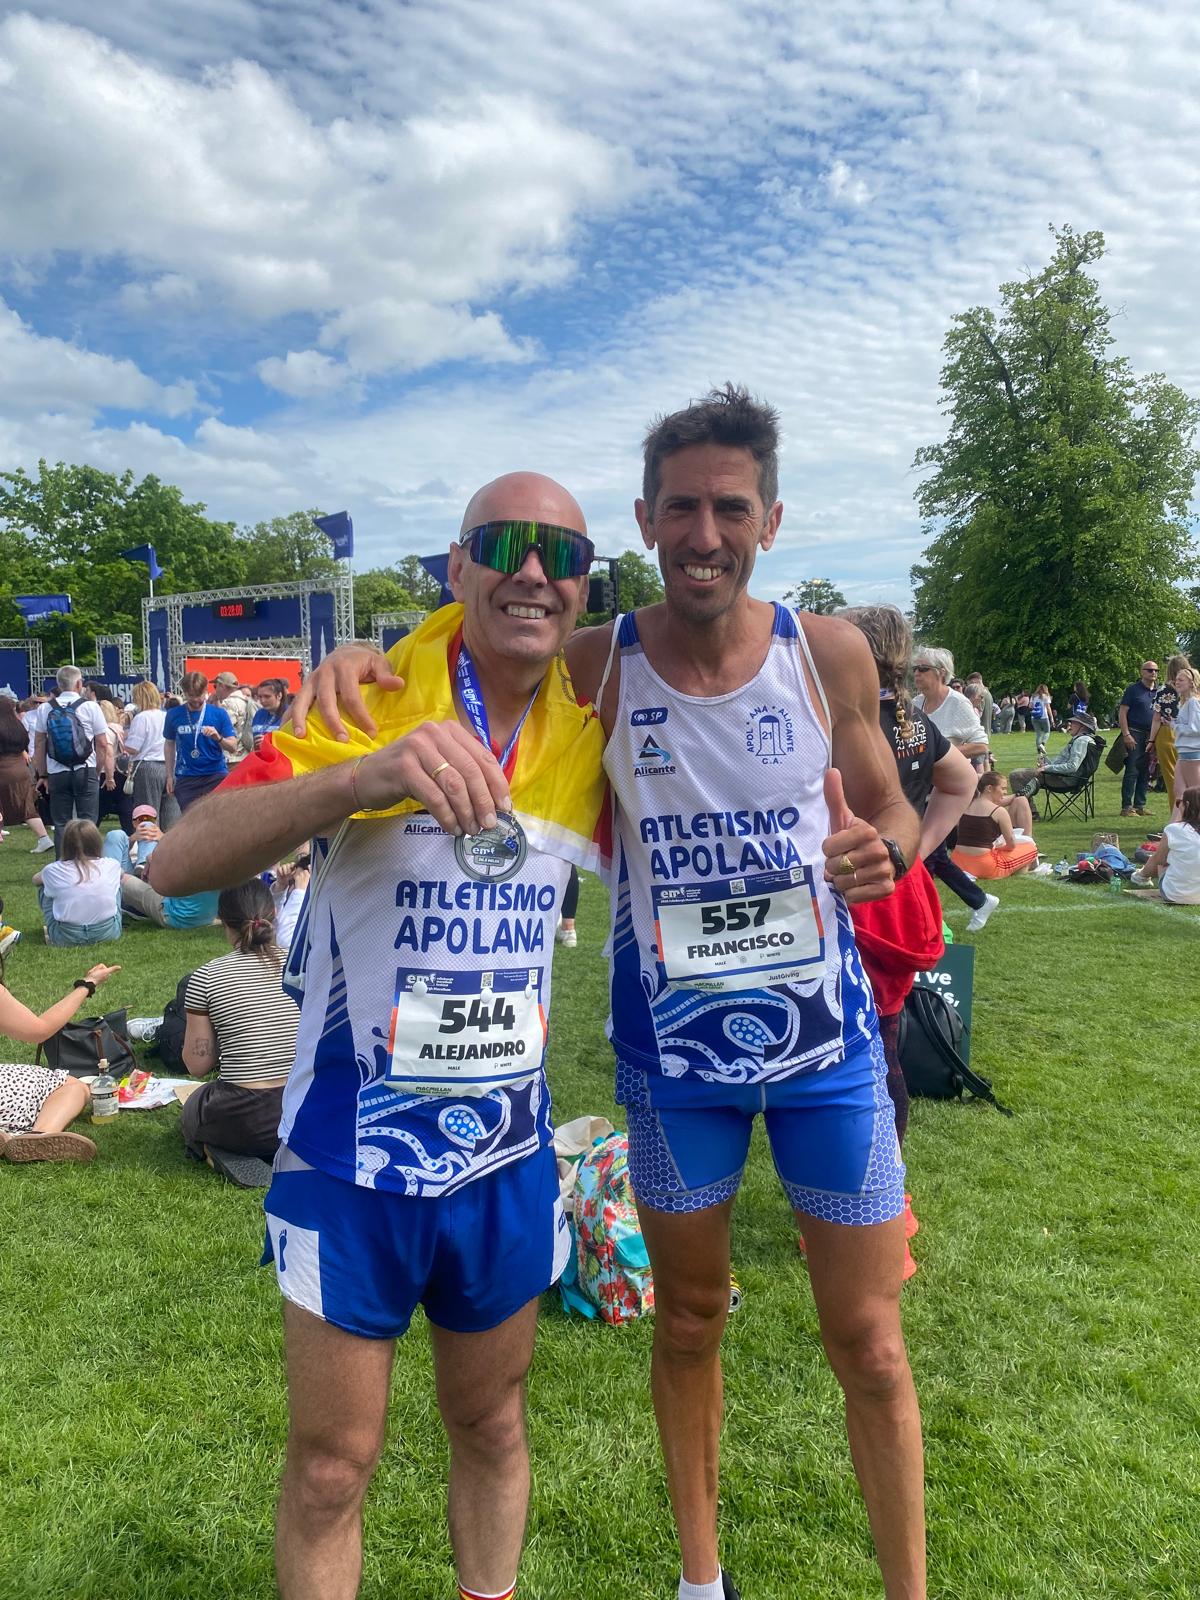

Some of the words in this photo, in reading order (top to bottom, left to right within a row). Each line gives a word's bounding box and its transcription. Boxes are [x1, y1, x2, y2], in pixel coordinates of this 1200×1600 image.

[762, 731, 773, 740] 21
[778, 708, 794, 752] ALICANTE
[634, 765, 676, 776] Alicante
[404, 823, 447, 834] Alican
[640, 807, 800, 843] ATLETISMO
[472, 846, 496, 855] emf
[651, 837, 802, 880] APOLANA
[395, 880, 556, 911] ATLETISMO
[660, 886, 685, 898] emf
[701, 898, 771, 935] 557
[394, 915, 544, 954] APOLANA
[687, 932, 795, 959] FRANCISCO
[768, 971, 800, 981] JustGiving
[438, 997, 515, 1034] 544
[418, 1040, 526, 1061] ALEJANDRO
